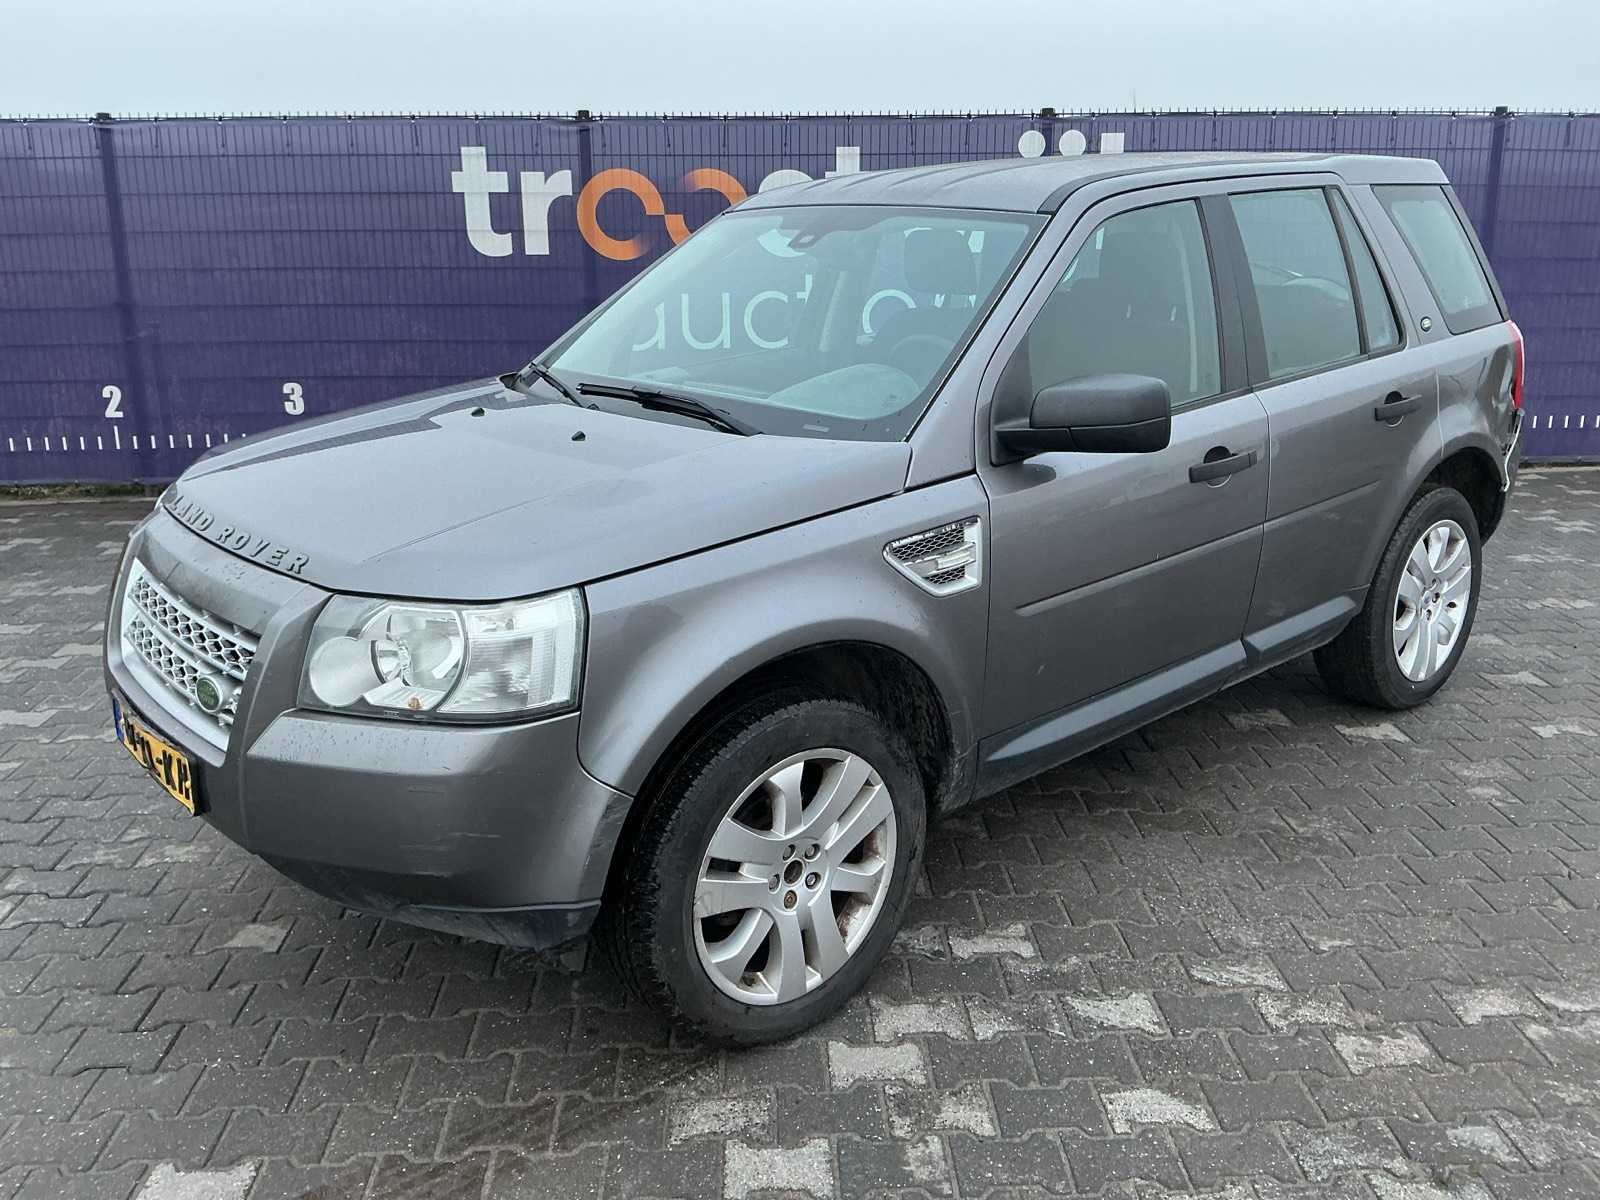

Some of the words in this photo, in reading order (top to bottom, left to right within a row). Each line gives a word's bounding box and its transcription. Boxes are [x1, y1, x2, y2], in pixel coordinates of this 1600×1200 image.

[102, 385, 124, 418] 2
[282, 382, 305, 416] 3
[168, 495, 215, 532] LAND
[216, 525, 310, 574] ROVER
